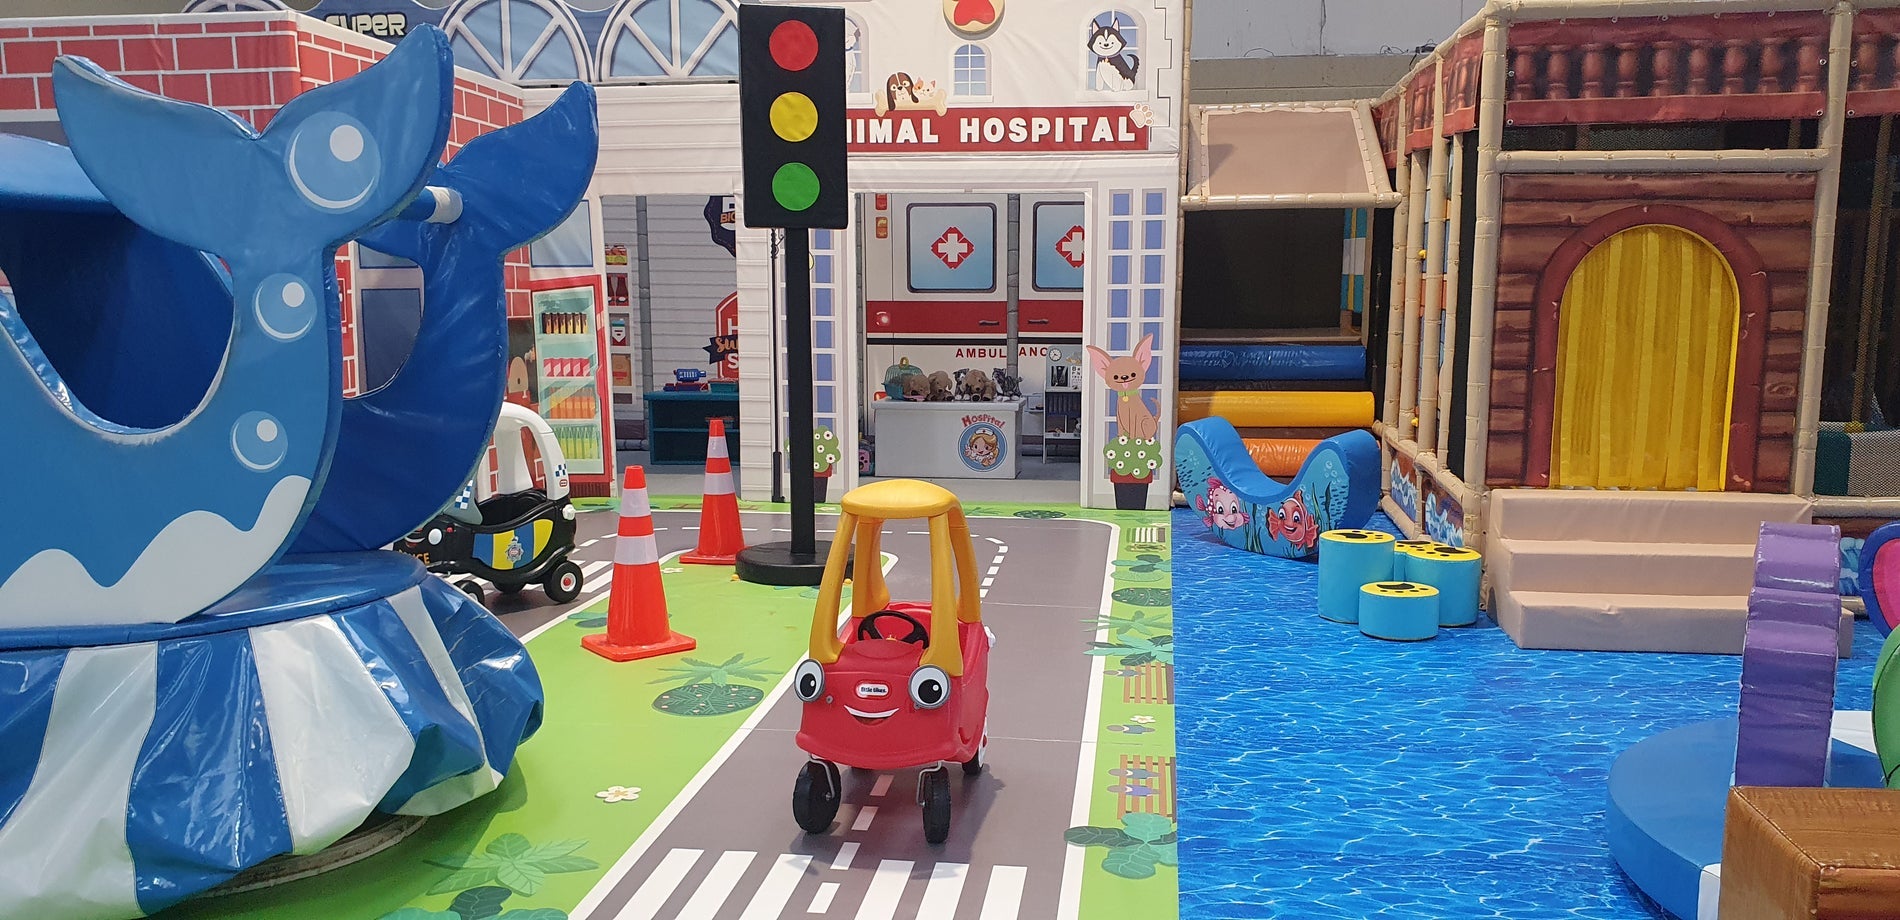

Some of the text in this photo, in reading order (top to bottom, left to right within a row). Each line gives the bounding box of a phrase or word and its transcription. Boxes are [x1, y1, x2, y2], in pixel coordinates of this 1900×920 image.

[846, 116, 1136, 144] IMAL HOSPITAL
[955, 347, 1048, 358] AMBULANC
[961, 413, 1006, 428] Hospital
